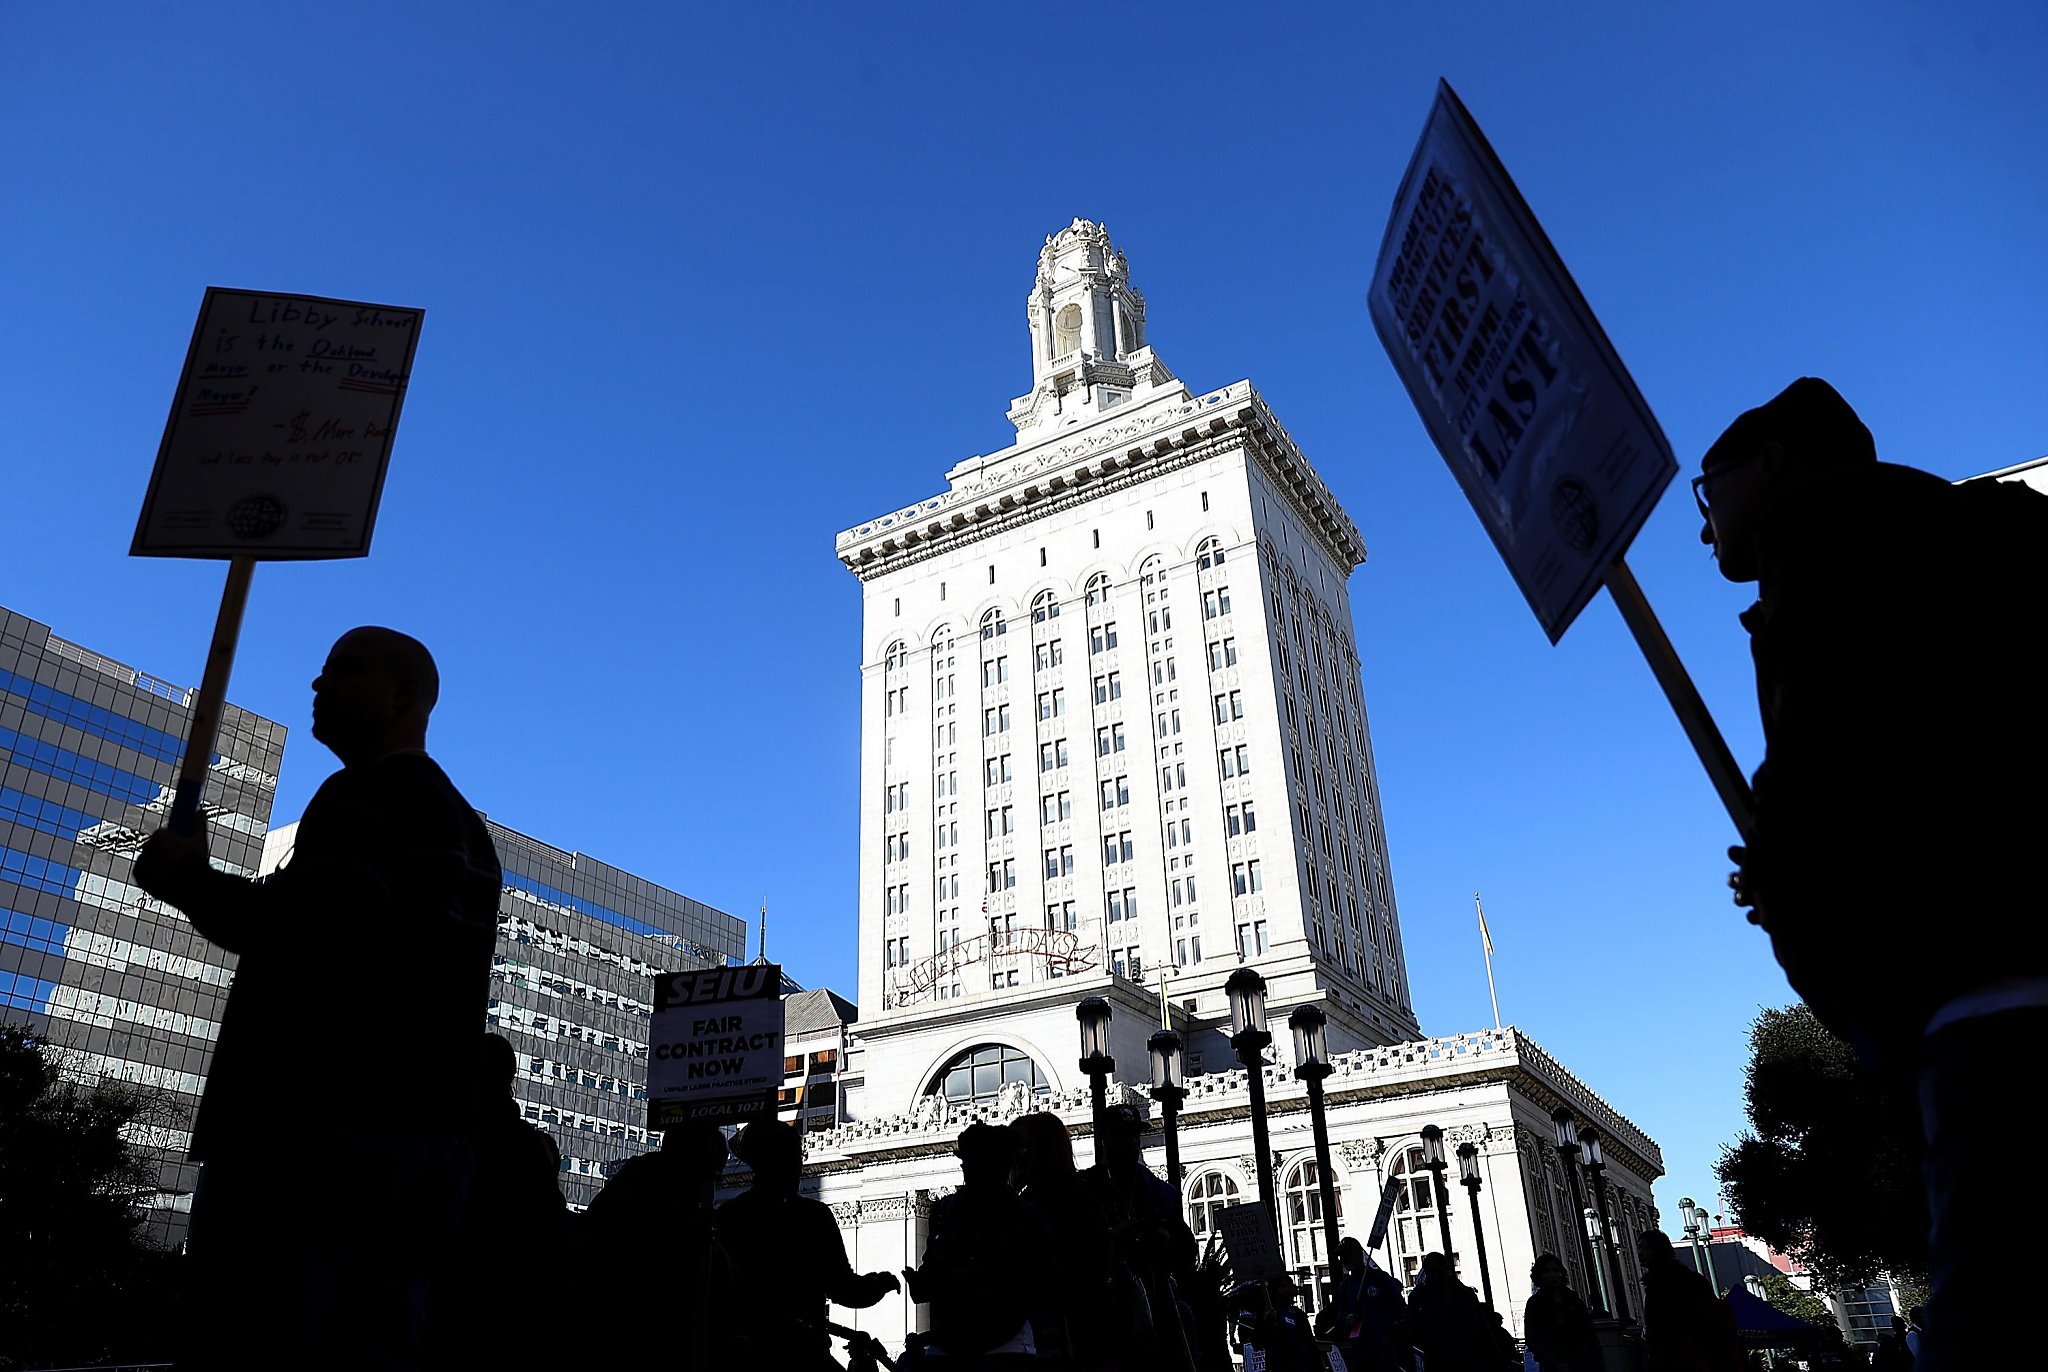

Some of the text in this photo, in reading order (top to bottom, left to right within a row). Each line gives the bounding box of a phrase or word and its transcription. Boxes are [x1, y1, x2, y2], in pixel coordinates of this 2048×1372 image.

[1389, 254, 1406, 293] YOU
[1420, 167, 1440, 207] PUT
[1396, 176, 1455, 322] COMMUNITY
[1407, 200, 1472, 348] SERVICES
[249, 301, 337, 331] Libby
[1423, 232, 1495, 388] FIRST
[216, 328, 240, 352] is
[257, 333, 294, 352] the
[1454, 301, 1502, 395] IF YOU PUT
[267, 363, 289, 373] or
[299, 360, 332, 374] the
[1458, 293, 1528, 435] CITY WORKERS
[1469, 318, 1559, 484] LAST
[313, 418, 355, 440] More
[666, 967, 768, 1005] SEIU
[692, 1015, 743, 1037] FAIR
[655, 1031, 779, 1061] CONTRACT
[688, 1056, 746, 1080] NOW
[690, 1103, 734, 1119] LOCAL
[738, 1101, 766, 1114] 1021
